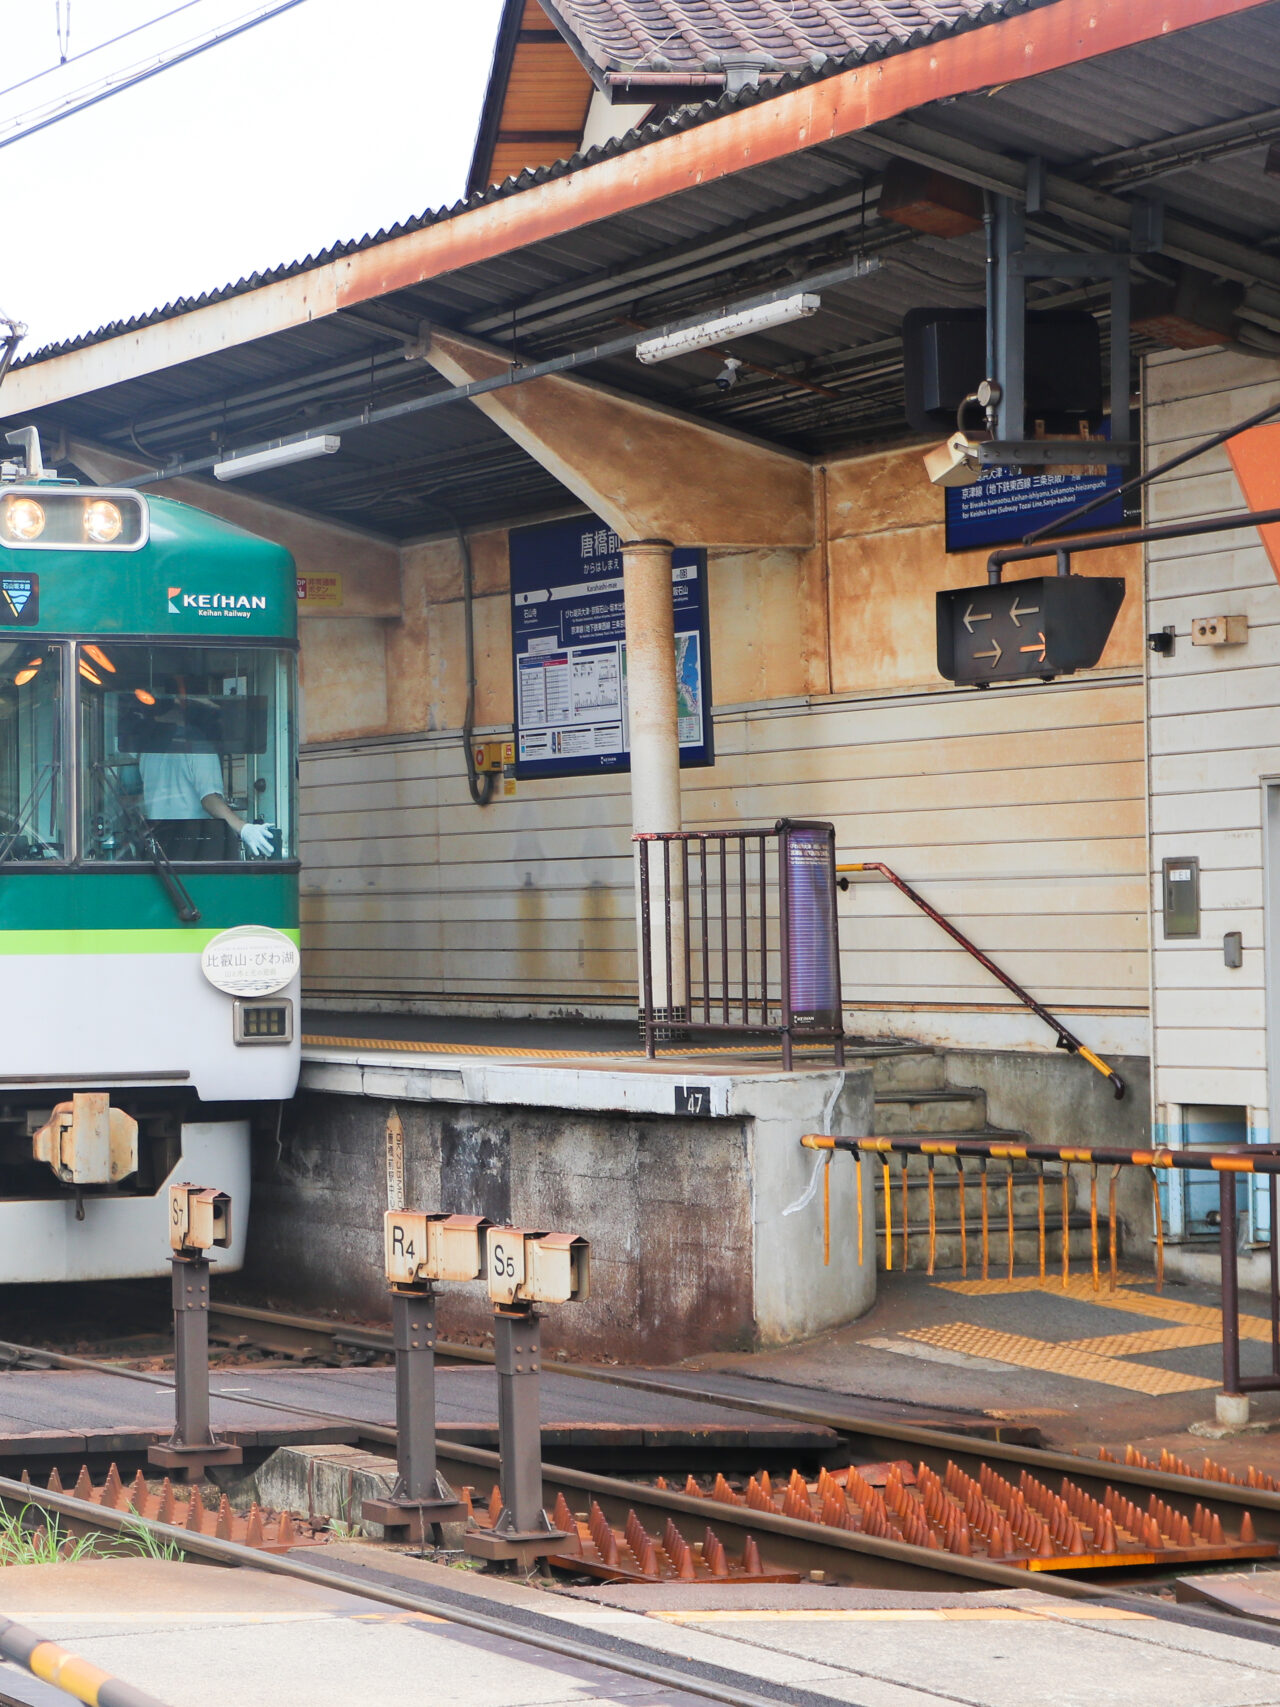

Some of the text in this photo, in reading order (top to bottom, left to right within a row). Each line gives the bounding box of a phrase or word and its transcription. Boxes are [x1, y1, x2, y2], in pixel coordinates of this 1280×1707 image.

[584, 558, 619, 575] からはしまえ
[183, 594, 266, 609] KEIHAN
[198, 609, 251, 618] Keihan Railway
[1172, 871, 1190, 880] TEL
[206, 951, 294, 967] 比叡山・びわ湖
[687, 1093, 702, 1114] 47
[172, 1197, 184, 1226] S7
[393, 1225, 415, 1260] R4
[494, 1243, 515, 1279] S5
